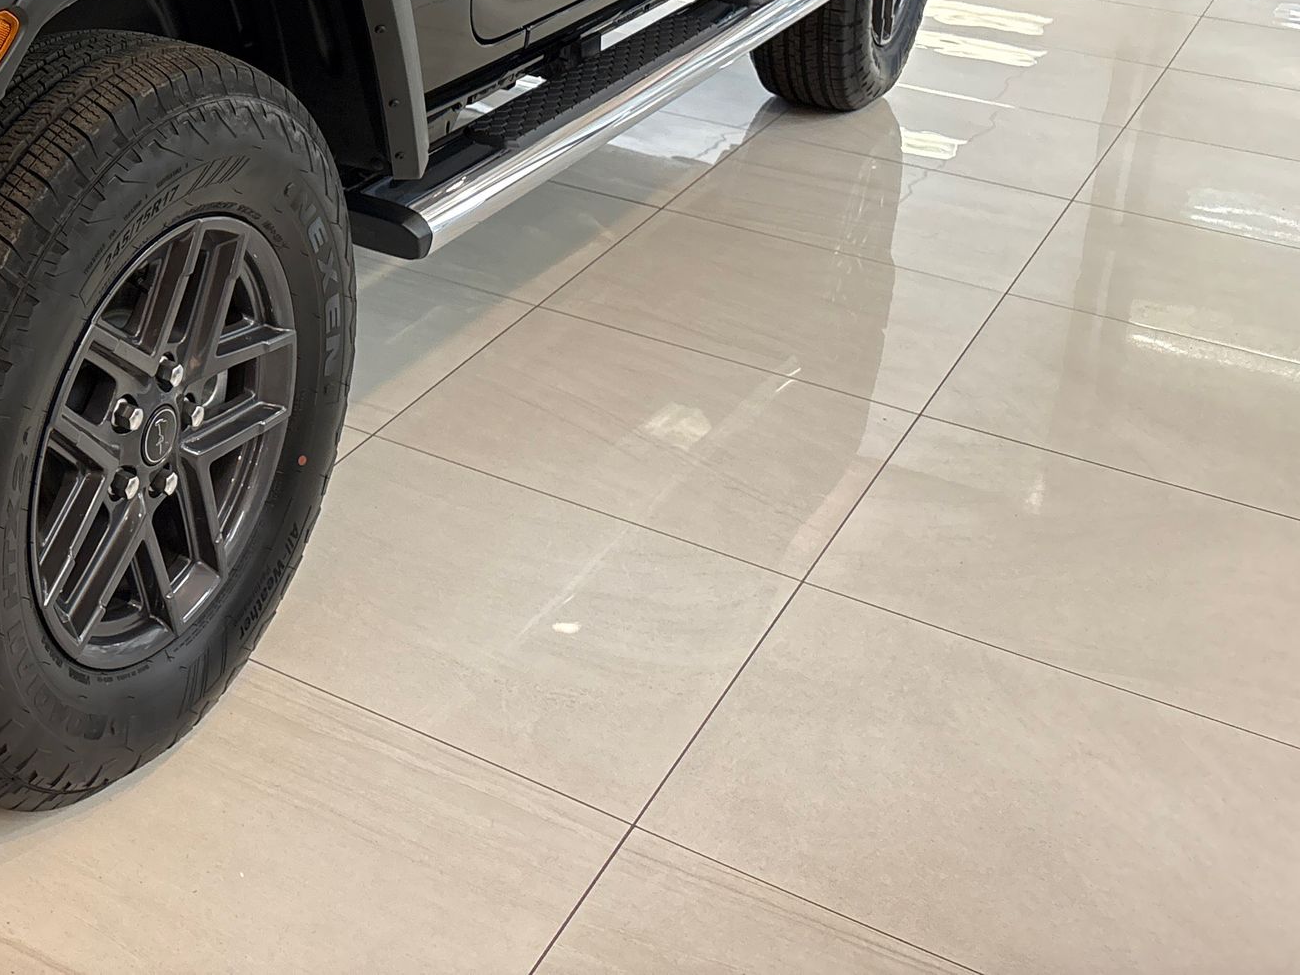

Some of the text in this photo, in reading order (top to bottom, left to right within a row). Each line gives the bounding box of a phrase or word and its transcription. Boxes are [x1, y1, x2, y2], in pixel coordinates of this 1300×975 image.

[103, 183, 180, 272] 245/75R17
[296, 188, 341, 378] NEXEN
[239, 521, 300, 641] All-Weather
